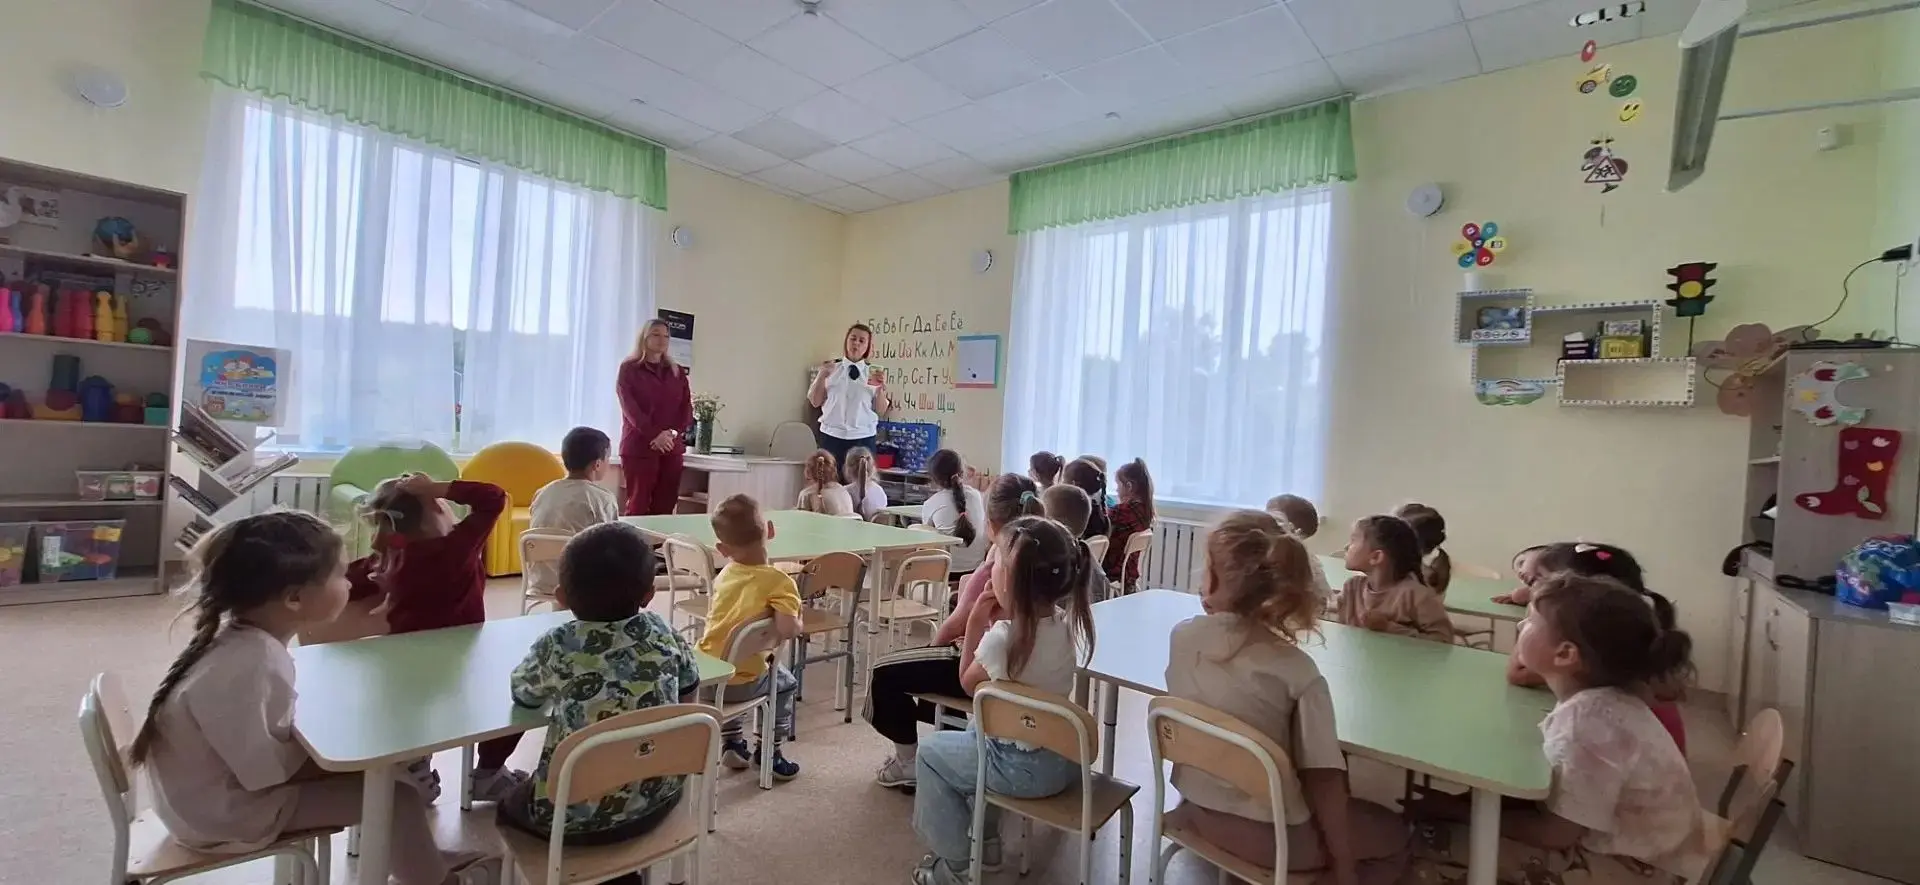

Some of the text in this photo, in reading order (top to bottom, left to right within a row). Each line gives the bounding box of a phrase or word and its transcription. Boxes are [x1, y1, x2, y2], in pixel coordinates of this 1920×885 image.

[883, 317, 896, 334] Вв
[899, 316, 910, 333] Гг
[912, 314, 932, 334] Дд
[935, 314, 947, 331] Ее
[883, 342, 896, 359] Ии
[899, 339, 912, 359] Йй
[915, 341, 927, 358] Кк
[931, 340, 944, 358] Лл
[897, 368, 909, 389] Рр
[911, 368, 924, 385] Сс
[926, 367, 939, 385] Тт
[904, 392, 916, 410] Чч
[919, 392, 934, 410] Шш
[937, 392, 956, 413] Щщ
